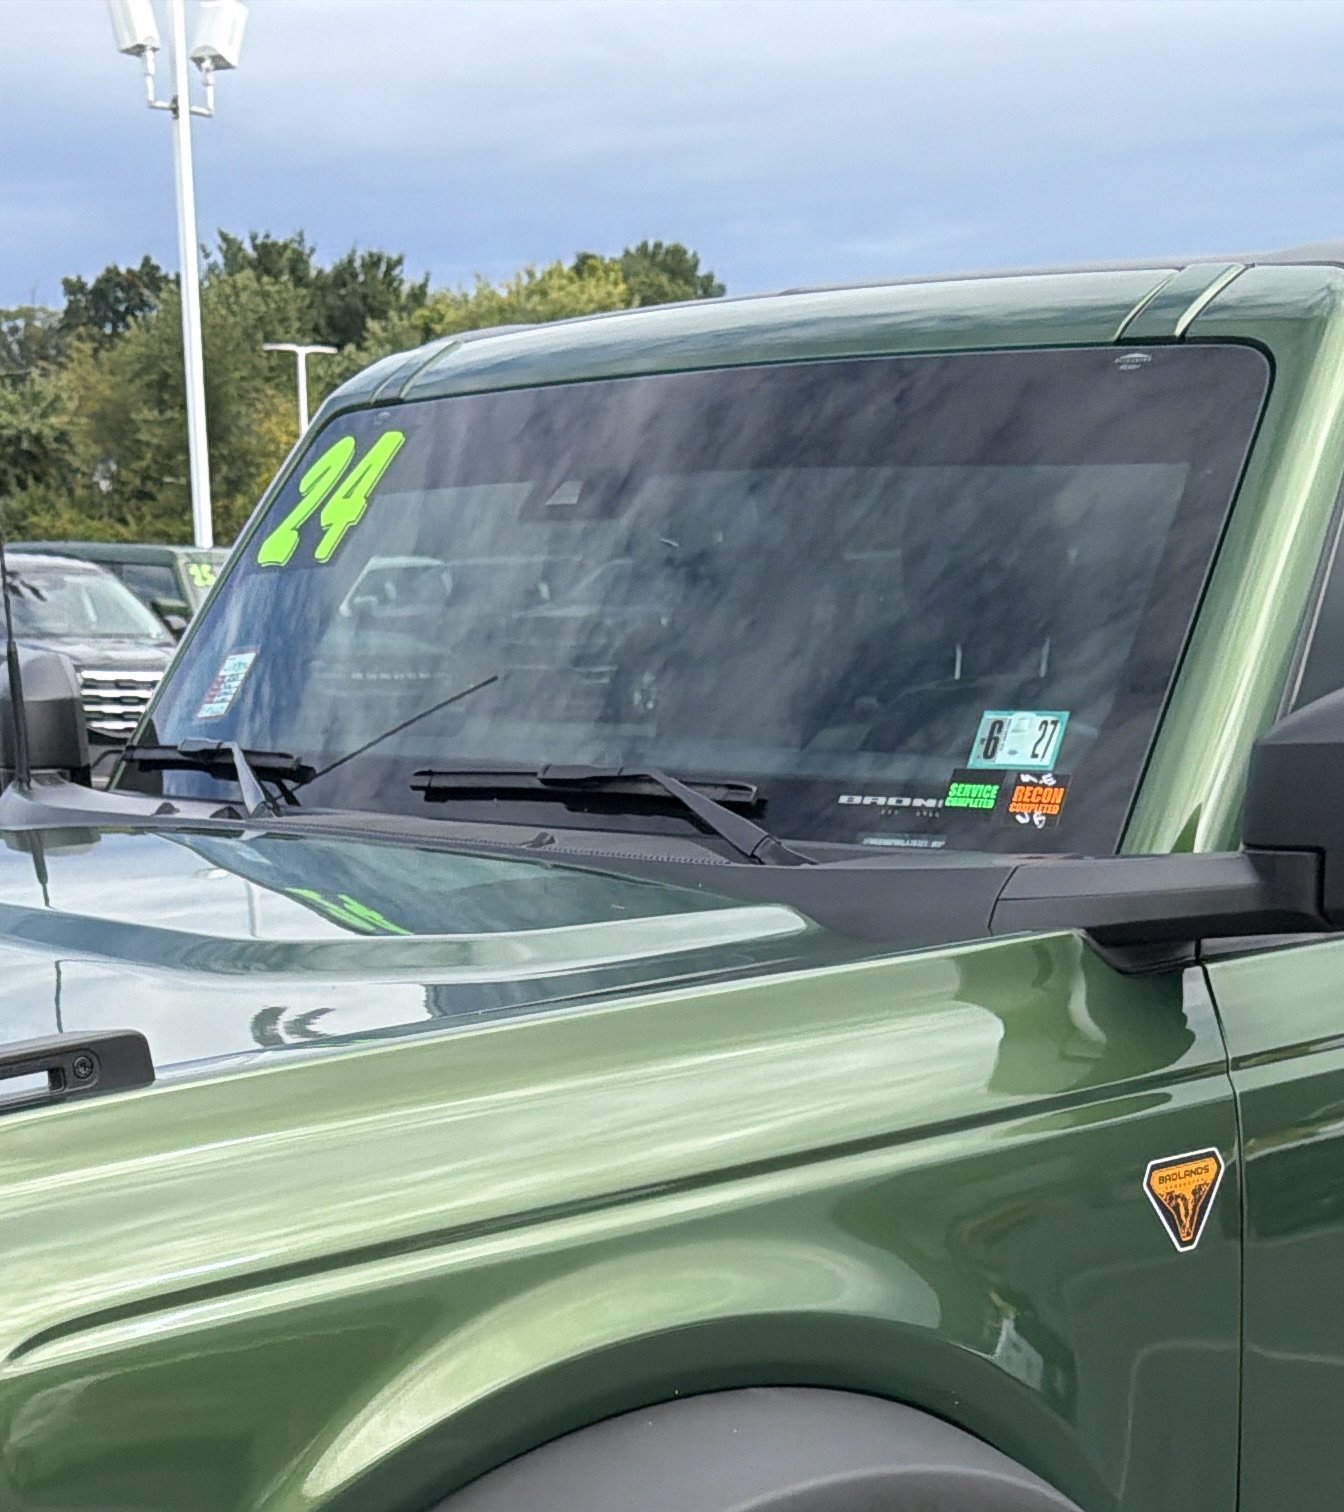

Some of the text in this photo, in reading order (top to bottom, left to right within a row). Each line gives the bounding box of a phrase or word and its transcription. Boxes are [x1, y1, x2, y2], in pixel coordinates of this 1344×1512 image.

[257, 431, 405, 567] 24
[982, 719, 1059, 762] 6 27
[948, 782, 1000, 799] SERVICE
[1012, 785, 1065, 803] RECON
[838, 795, 944, 808] BRON
[1157, 1164, 1209, 1185] BADLANDS
